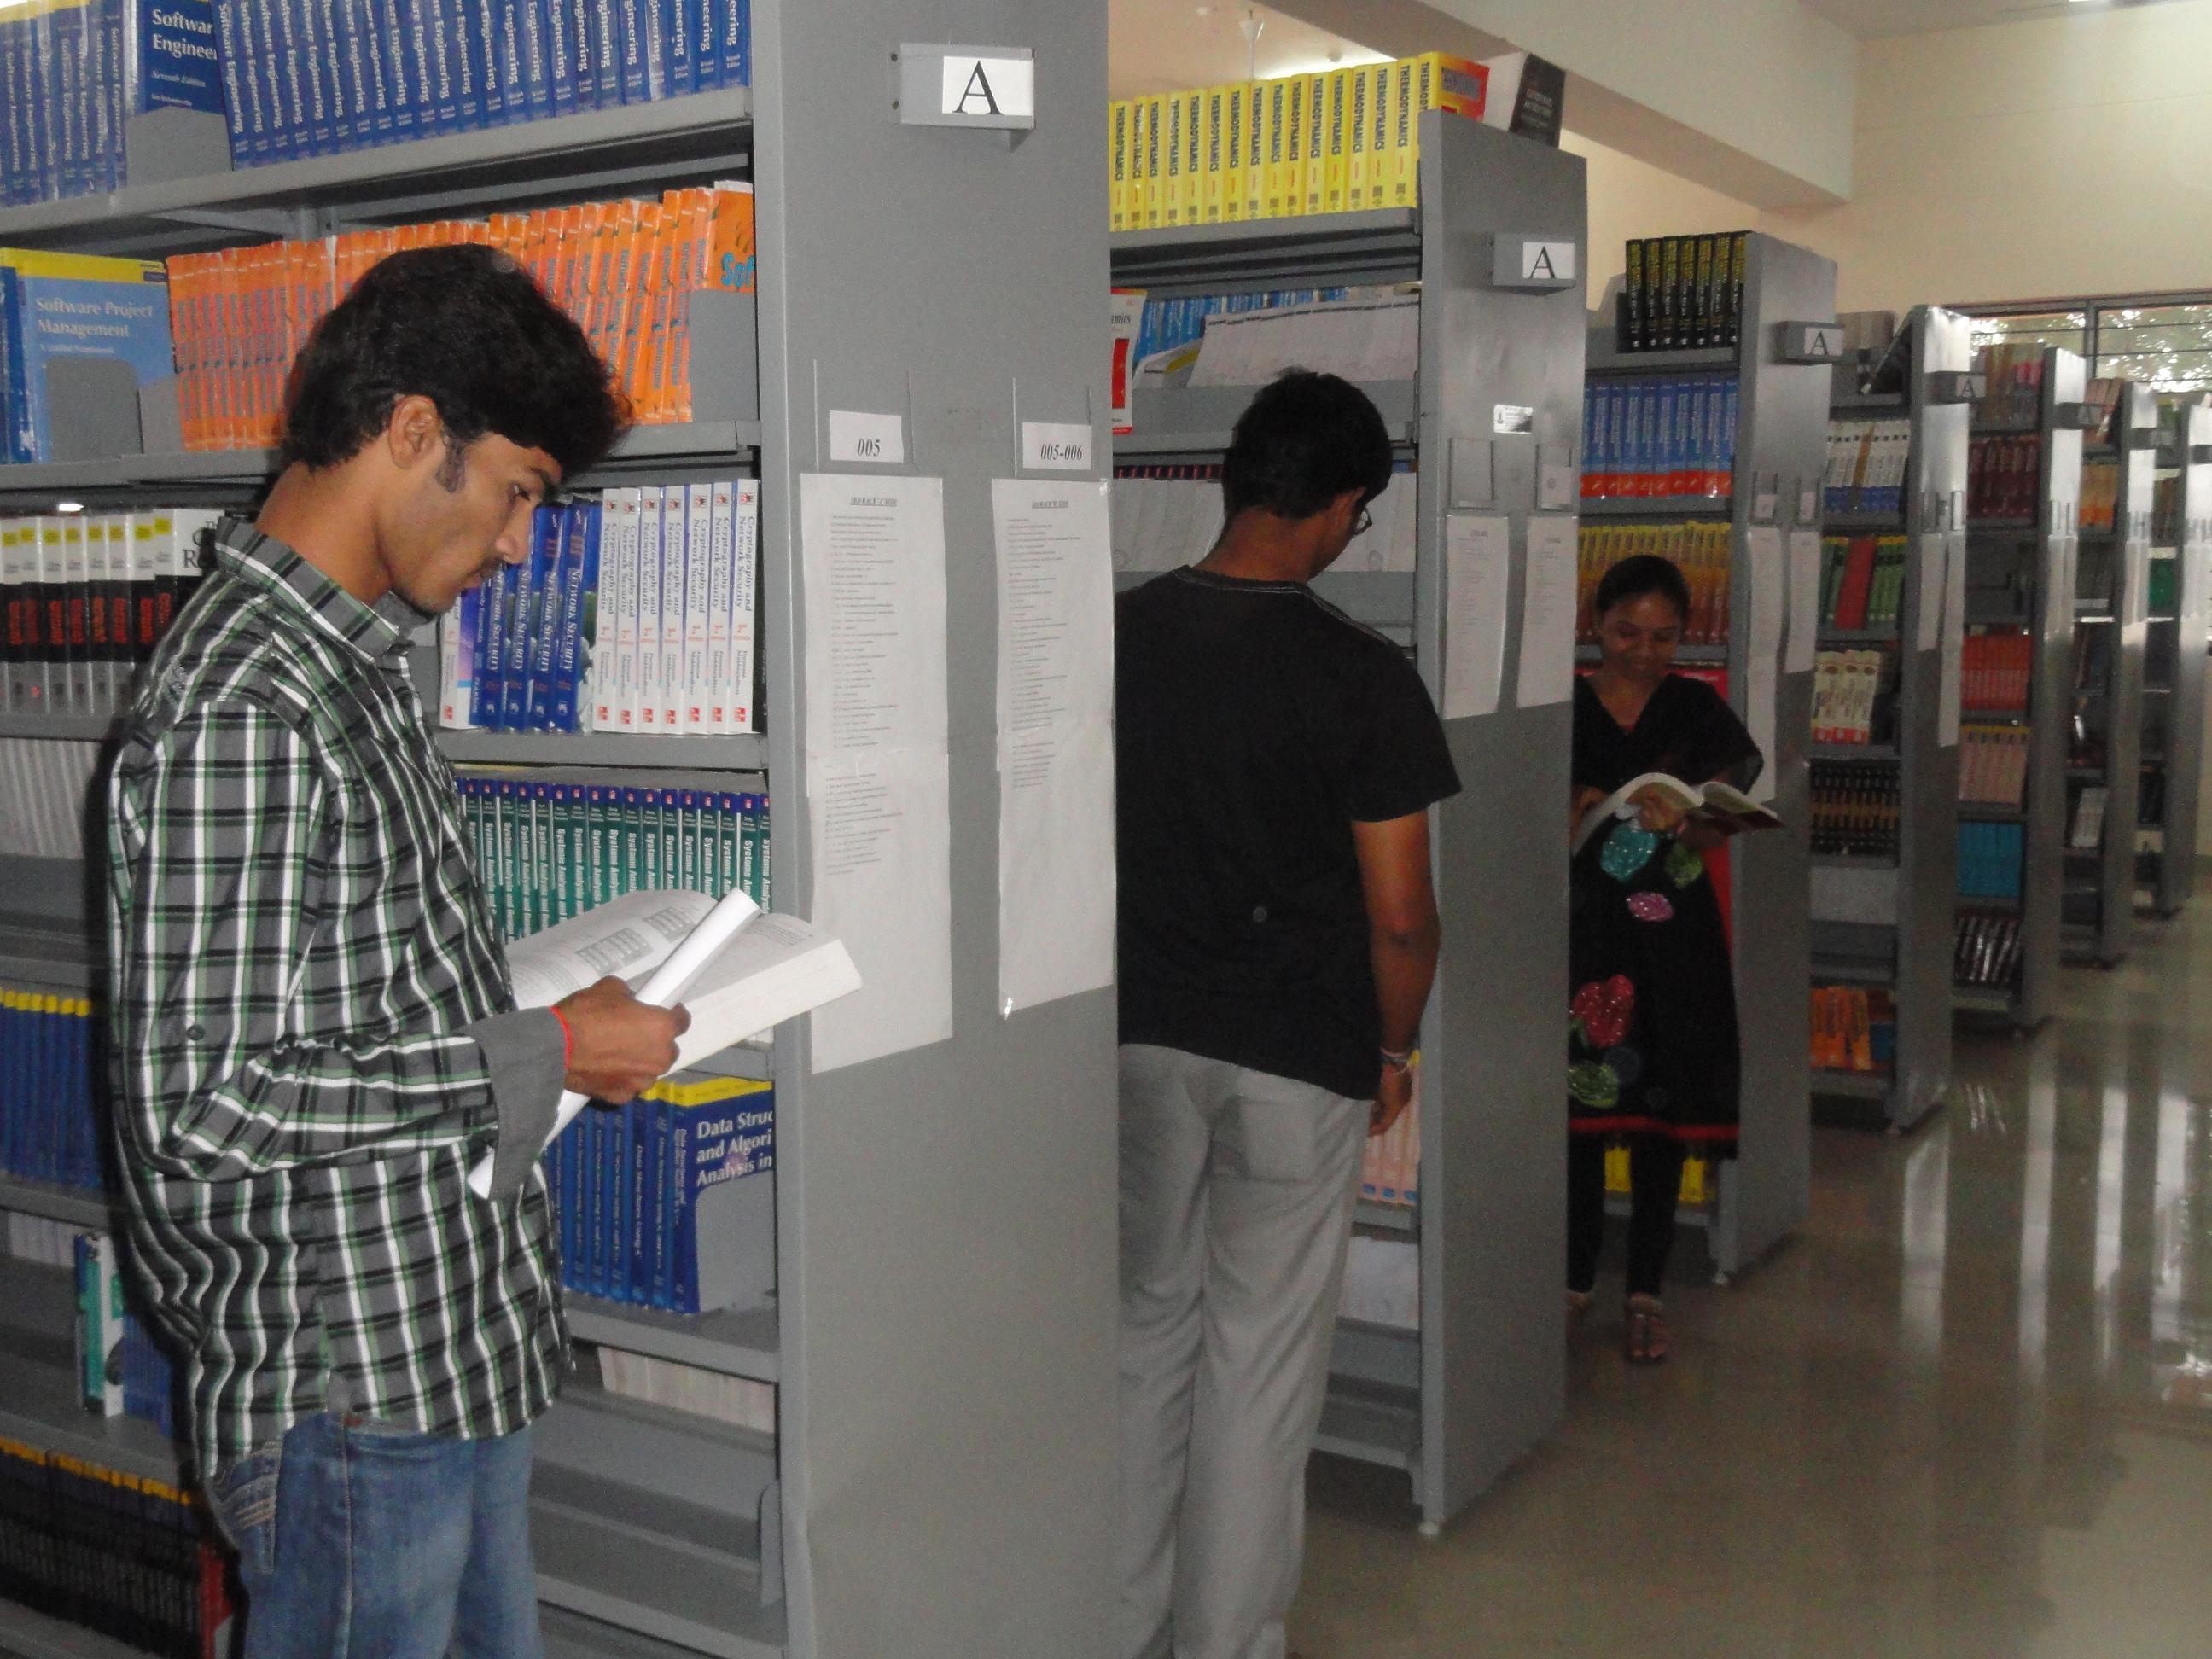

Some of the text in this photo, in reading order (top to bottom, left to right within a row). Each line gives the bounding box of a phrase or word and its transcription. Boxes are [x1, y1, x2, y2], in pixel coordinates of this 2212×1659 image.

[152, 9, 212, 34] Softwar
[575, 0, 591, 71] ngineering
[597, 0, 613, 68] ngineering
[624, 0, 639, 65] gineering
[648, 0, 662, 62] gineering
[674, 0, 687, 56] ineering
[701, 0, 713, 51] neering
[726, 0, 739, 45] eering
[952, 61, 1003, 114] A
[1419, 62, 1430, 109] THERMODY
[1528, 246, 1556, 279] A
[1809, 330, 1832, 357] A
[857, 438, 880, 457] 005
[1040, 444, 1082, 461] 005-006
[696, 1119, 733, 1138] Data
[696, 1139, 725, 1163] and
[759, 1152, 772, 1168] in
